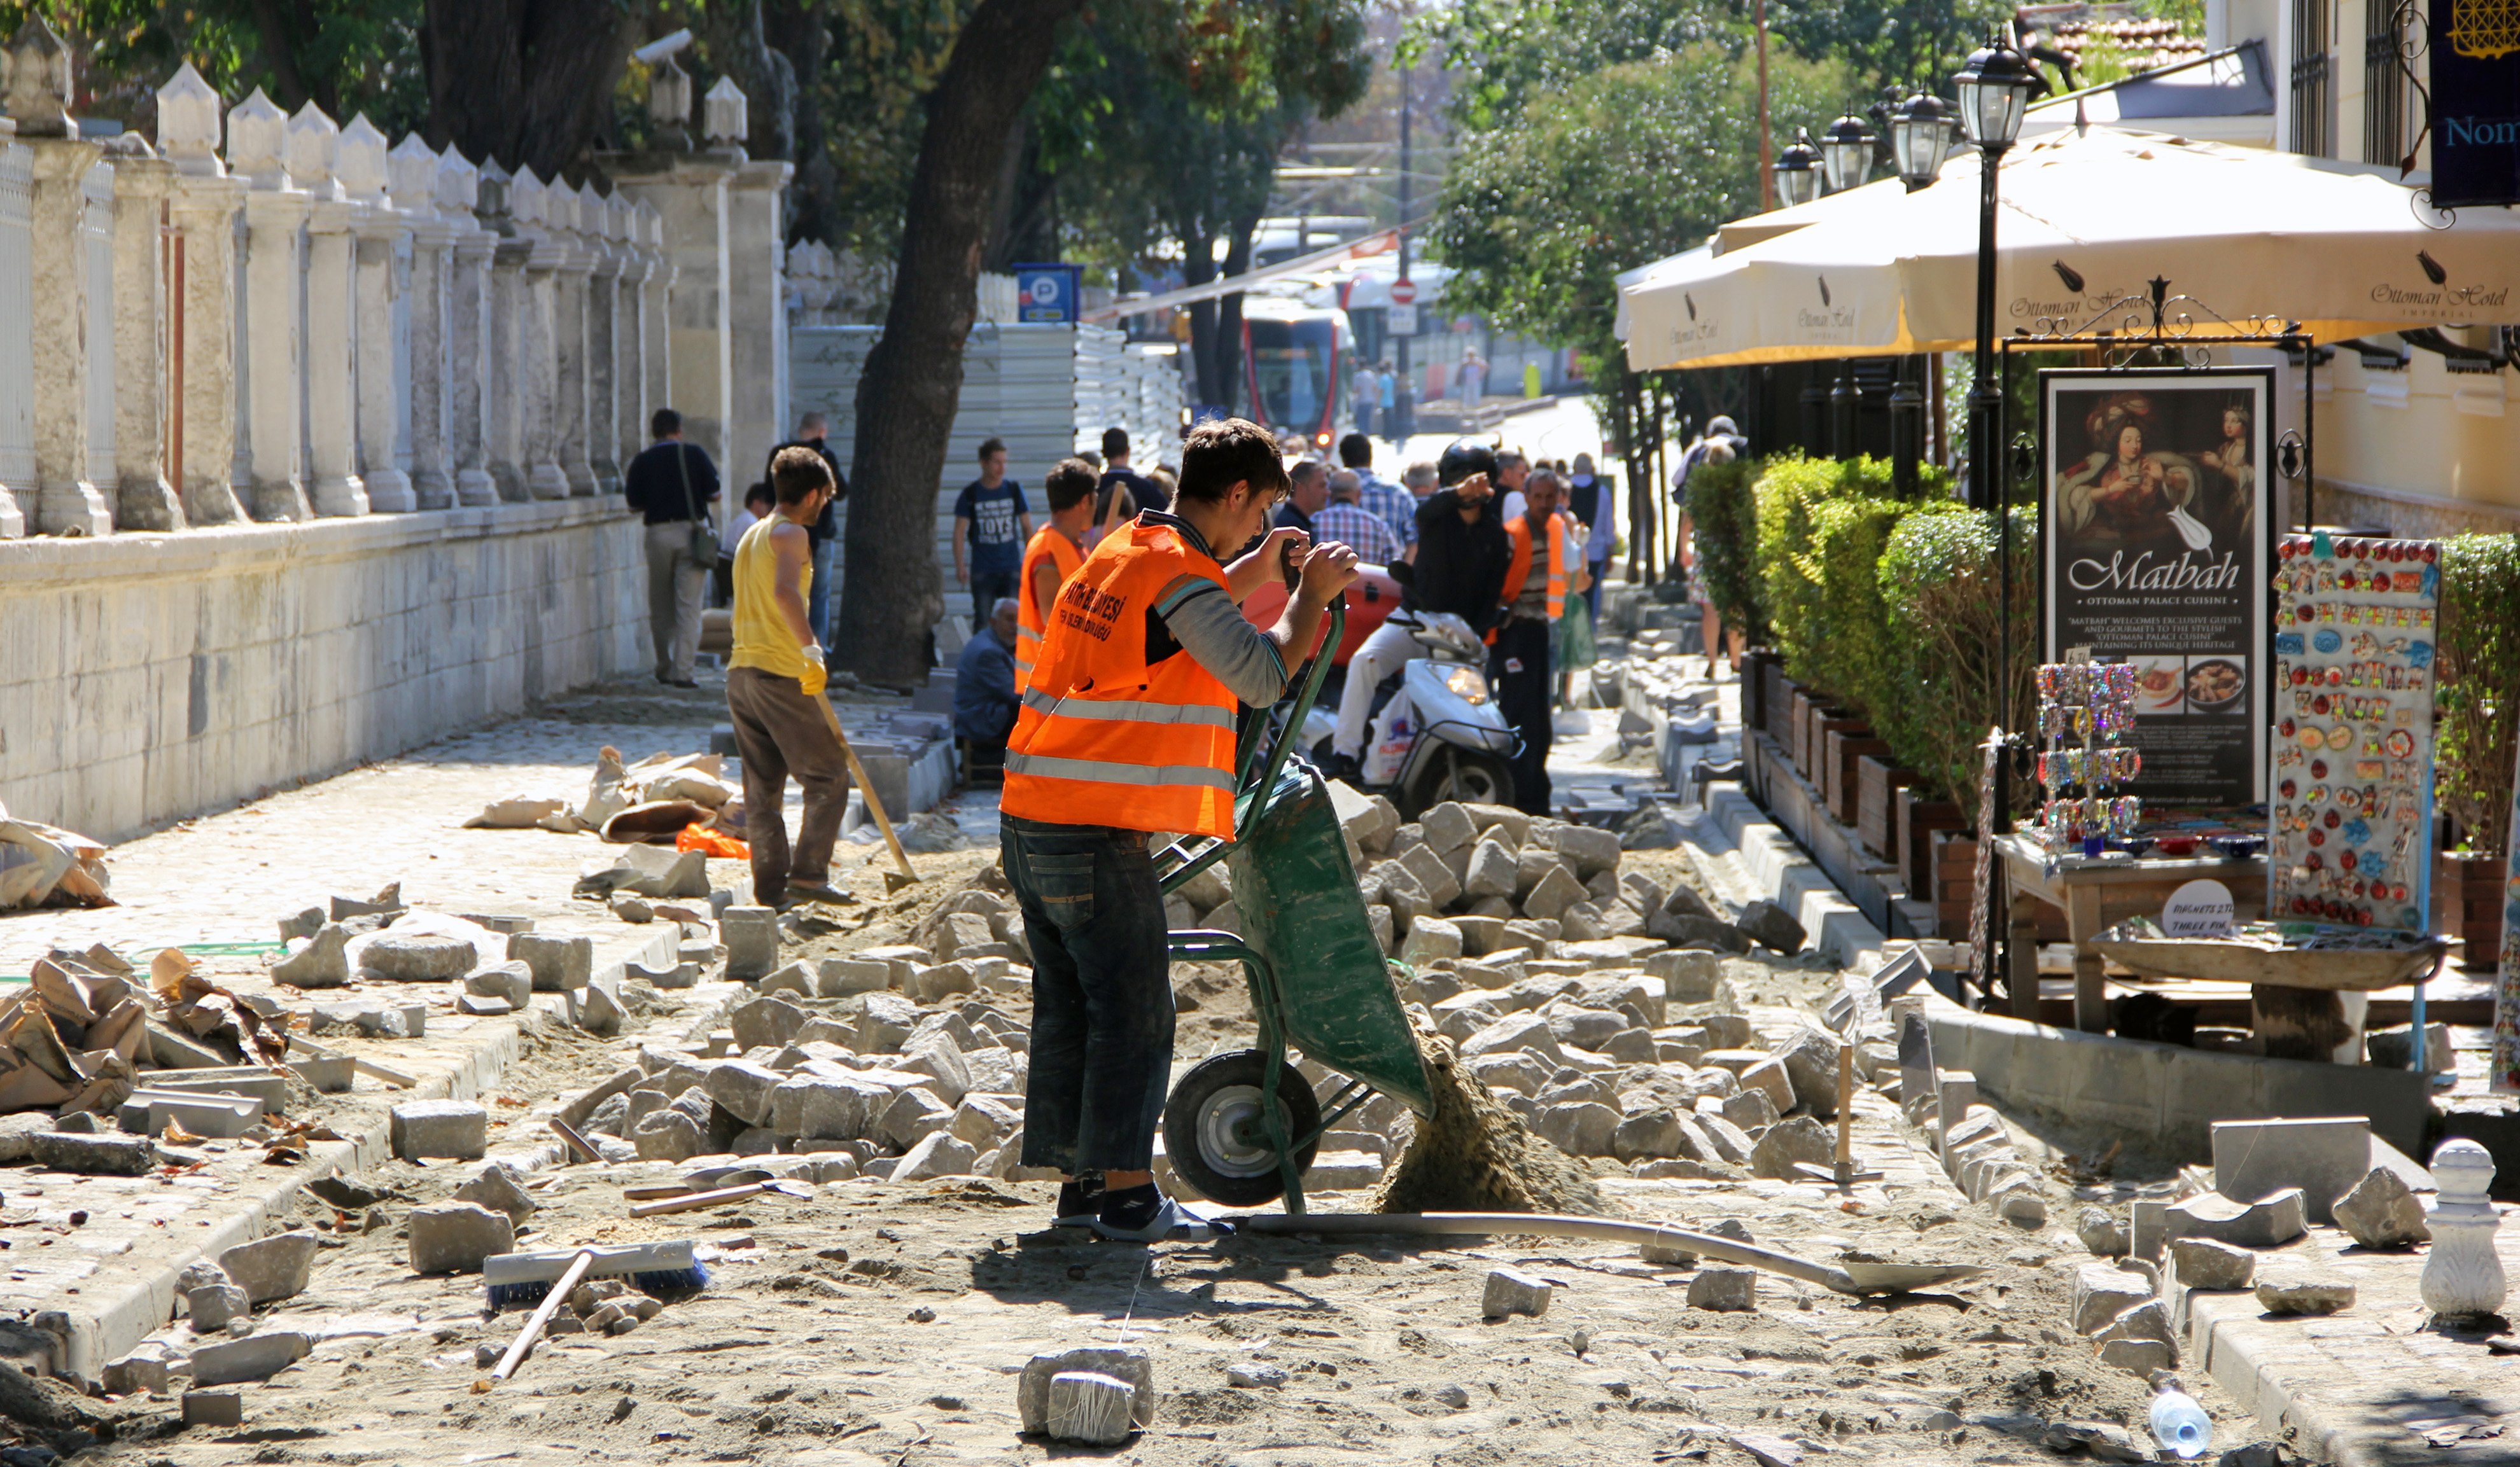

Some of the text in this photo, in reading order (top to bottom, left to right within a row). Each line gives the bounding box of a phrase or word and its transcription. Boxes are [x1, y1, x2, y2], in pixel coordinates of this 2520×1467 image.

[2371, 284, 2509, 306] Ottoman Hotel
[2010, 297, 2081, 317] Ottoman
[2403, 310, 2473, 318] IMPERIAL
[977, 515, 1014, 534] TOYS
[2069, 550, 2240, 591] Matbah
[2087, 595, 2228, 605] OTTOMAN PALACE CUISINE
[2163, 616, 2208, 624] EXCLUSIVE
[2106, 625, 2155, 633] GOURMETS
[2146, 632, 2176, 641] PALACE
[2139, 641, 2152, 649] ITS
[2155, 640, 2190, 650] UNIQUE
[2192, 640, 2236, 648] HERITAGE
[2069, 650, 2075, 664] 6
[2173, 903, 2216, 914] MAGNETS
[2173, 921, 2208, 931] THREE
